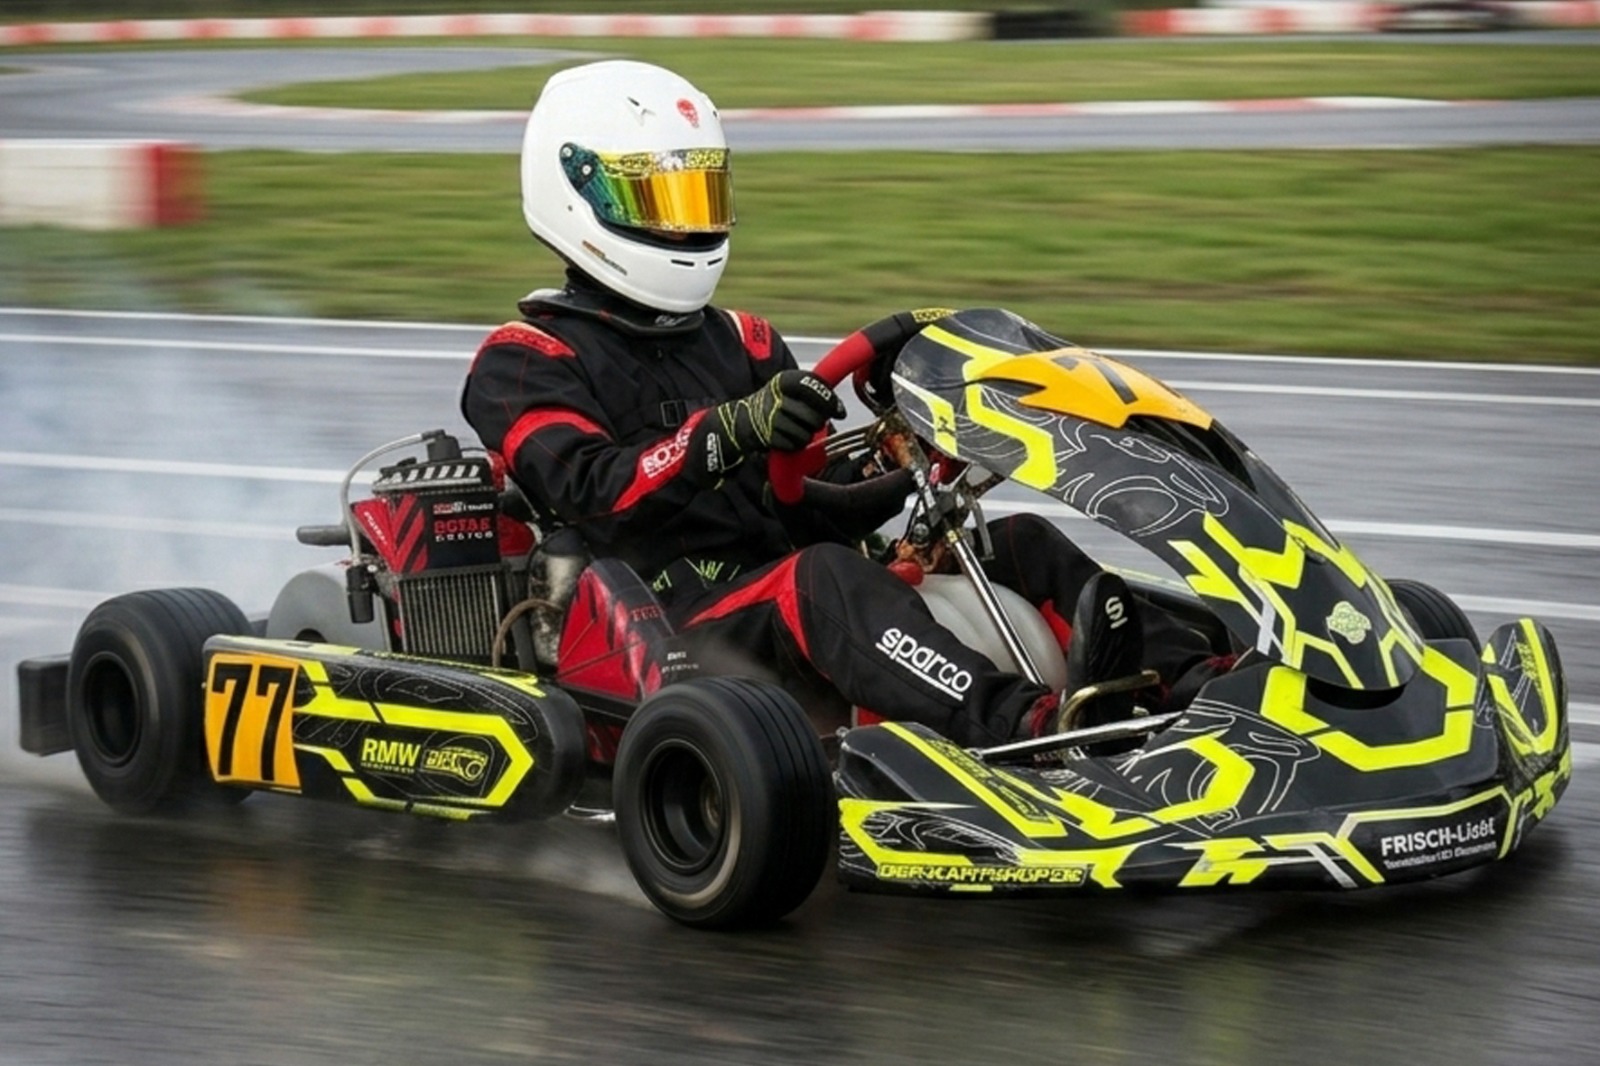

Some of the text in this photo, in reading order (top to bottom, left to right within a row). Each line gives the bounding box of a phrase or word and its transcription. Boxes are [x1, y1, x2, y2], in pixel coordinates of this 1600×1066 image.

[879, 627, 973, 698] sparco
[212, 662, 294, 781] 77
[361, 738, 421, 767] RMW
